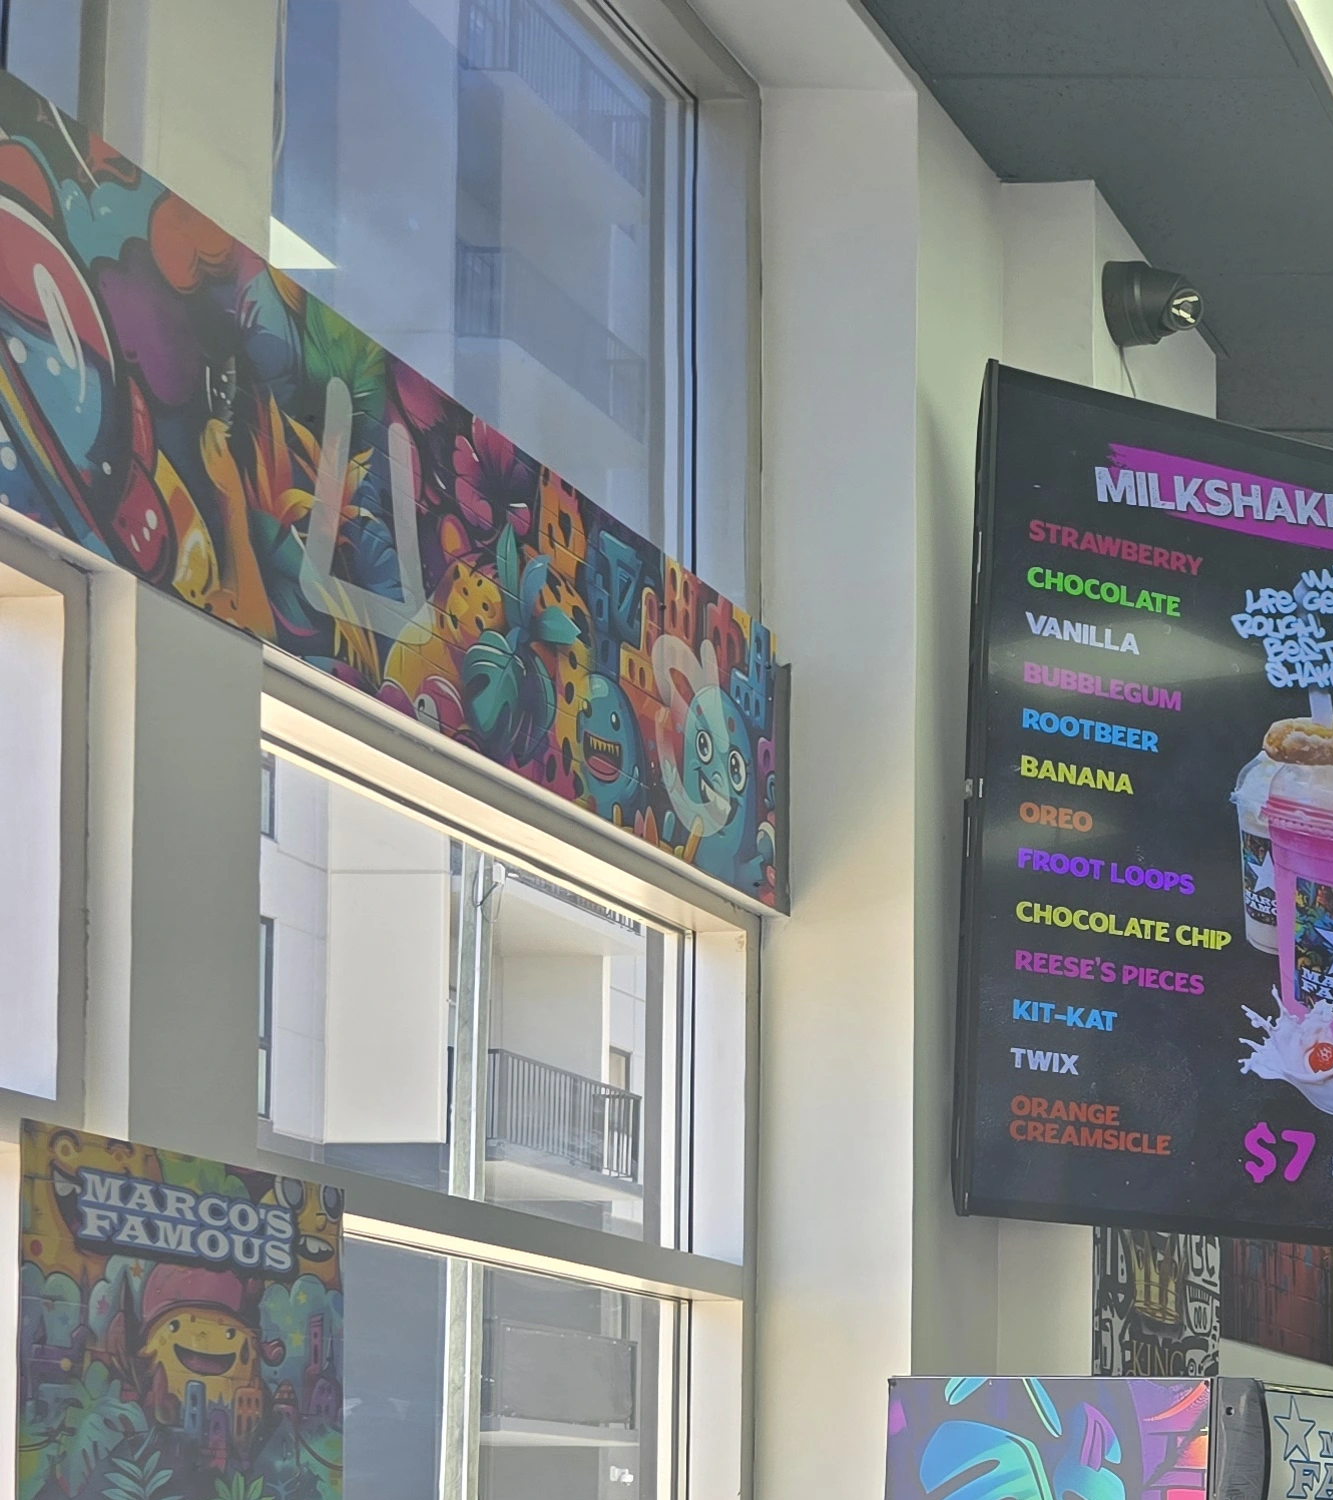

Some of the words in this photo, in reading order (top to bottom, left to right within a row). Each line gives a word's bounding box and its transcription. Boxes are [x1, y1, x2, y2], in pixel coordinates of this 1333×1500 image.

[1029, 519, 1203, 576] STRAWBERRY
[1027, 566, 1181, 617] CHOCOLATE
[1025, 611, 1139, 655] VANILLA
[1023, 661, 1182, 711] BUBBLEGUM
[1022, 708, 1159, 752] ROOTBEER
[1020, 755, 1134, 795] BANANA
[1020, 802, 1093, 832] OREO
[1017, 847, 1104, 880] FROOT
[1111, 862, 1195, 895] LOOPS
[1015, 901, 1170, 943] CHOCOLATE
[1176, 925, 1232, 950] CHIP
[1015, 950, 1116, 983] REESE'S
[1122, 965, 1205, 995] PIECES
[1012, 999, 1118, 1032] KIT-KAT
[1010, 1048, 1079, 1076] TWIX
[1010, 1095, 1120, 1126] ORANGE
[1009, 1120, 1171, 1155] CREAMSICLE
[1244, 1122, 1316, 1183] $7
[80, 1172, 294, 1240] MARCO'S
[81, 1206, 294, 1271] FAMOUS
